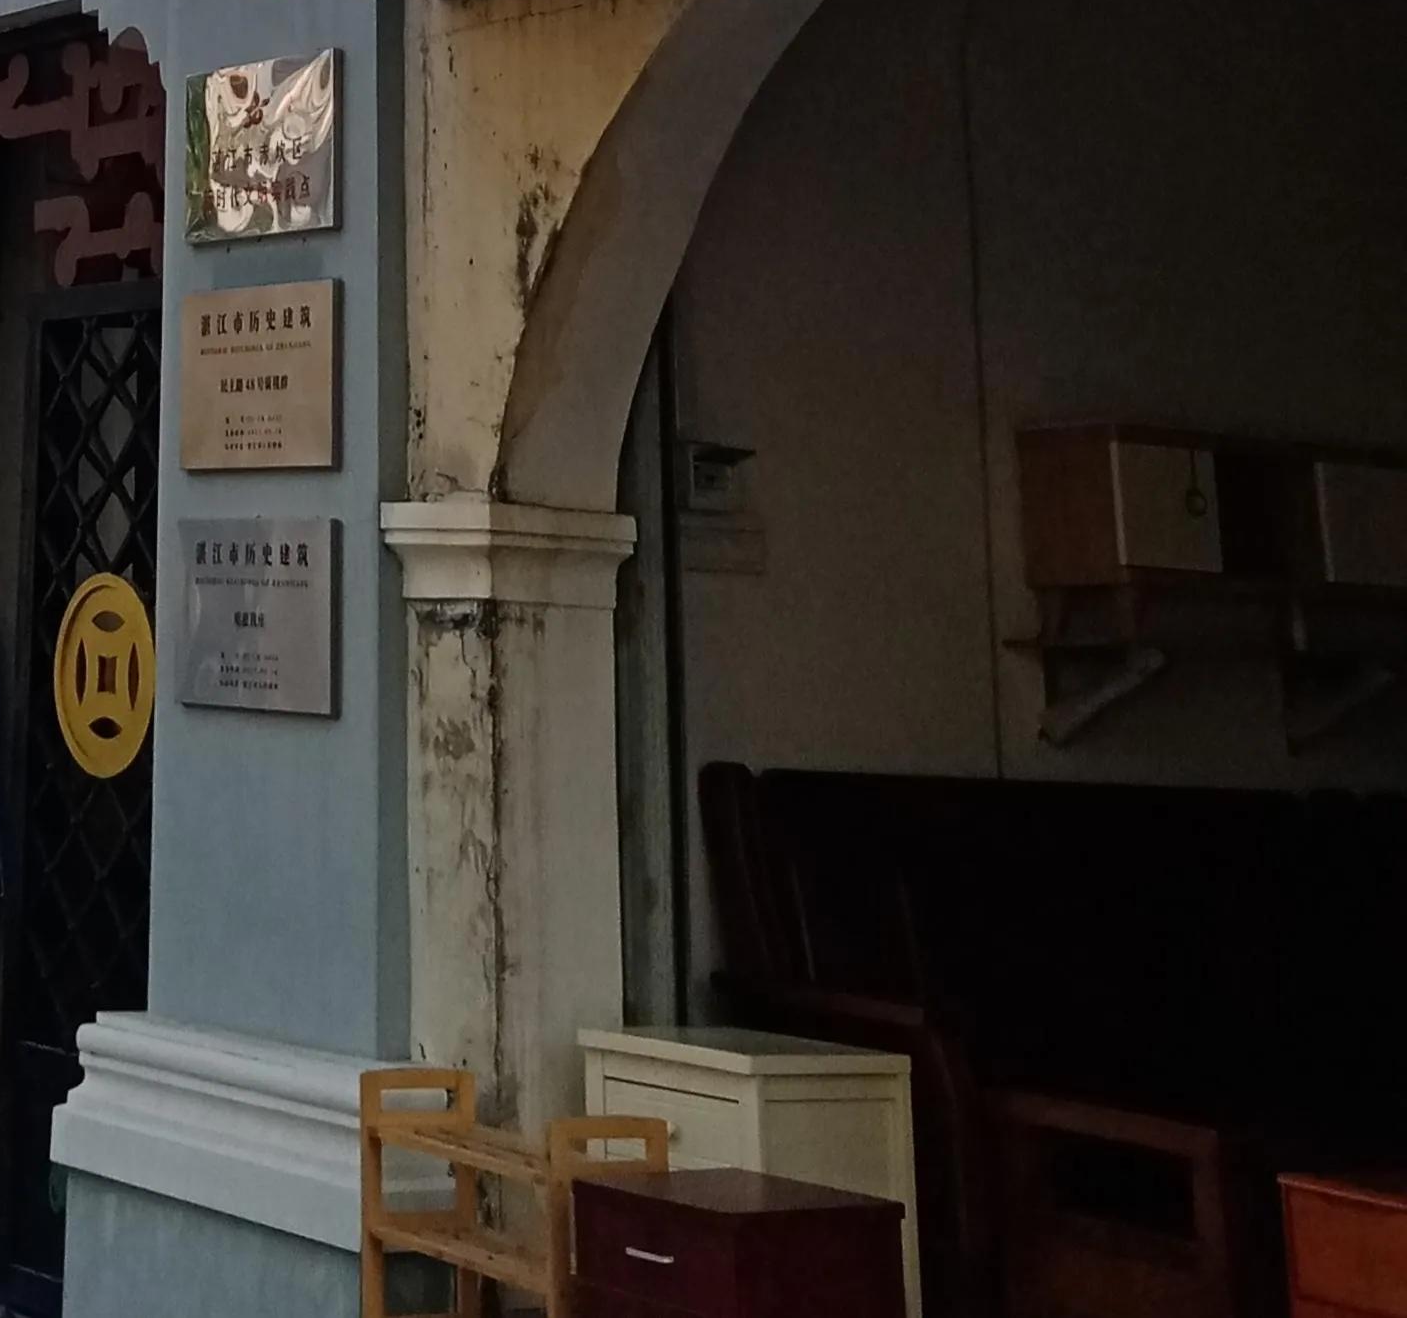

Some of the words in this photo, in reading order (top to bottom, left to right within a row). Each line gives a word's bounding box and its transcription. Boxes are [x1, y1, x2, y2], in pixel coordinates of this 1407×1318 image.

[200, 305, 312, 337] 湛江市历史建筑
[196, 540, 309, 568] 湛江市历史建筑
